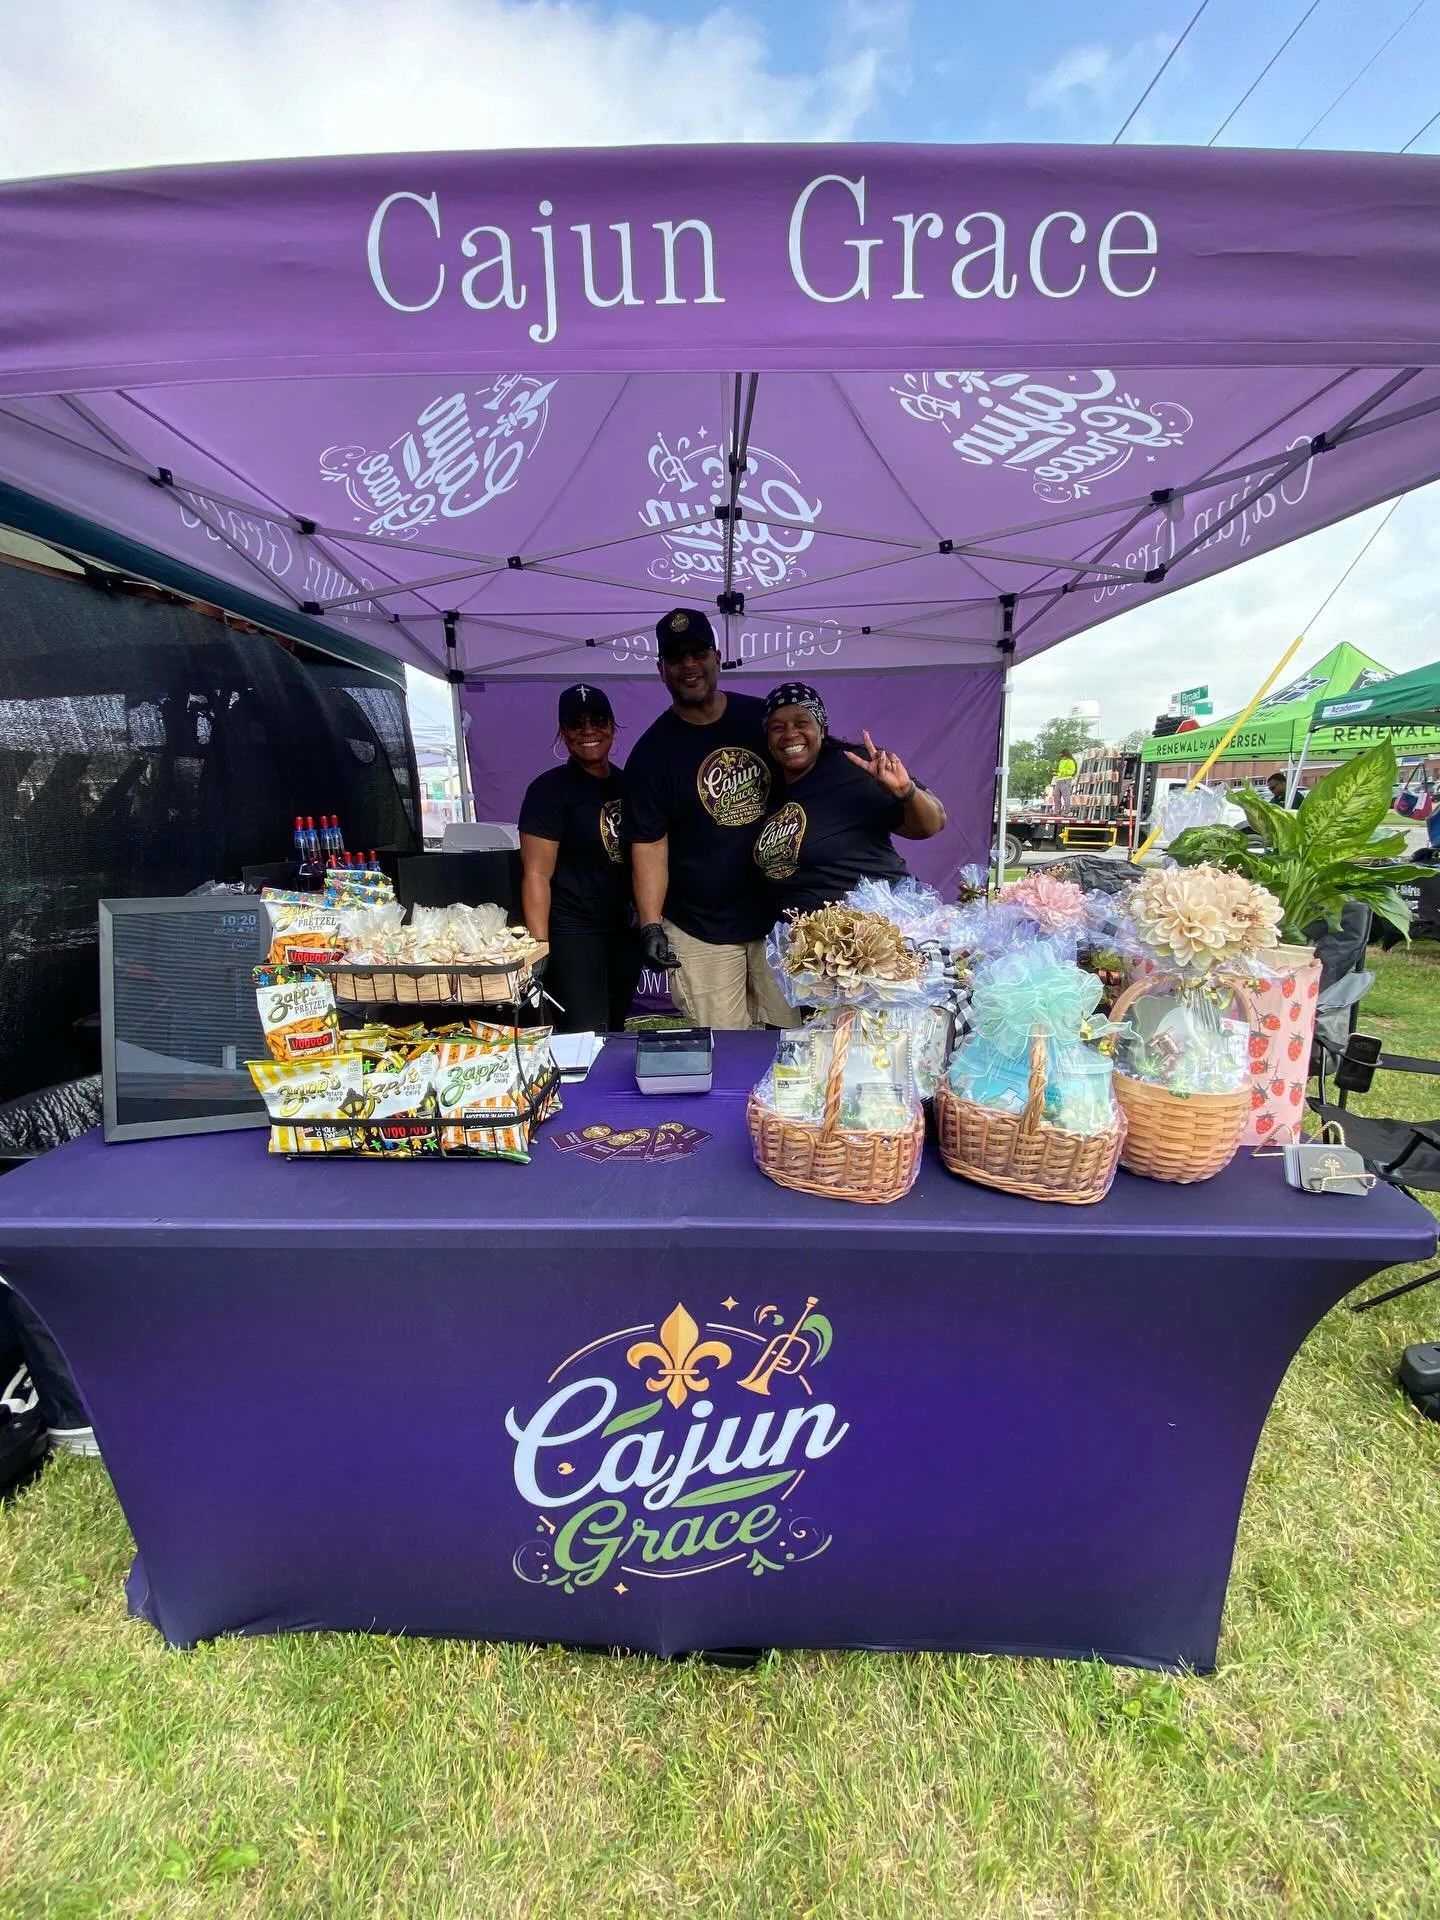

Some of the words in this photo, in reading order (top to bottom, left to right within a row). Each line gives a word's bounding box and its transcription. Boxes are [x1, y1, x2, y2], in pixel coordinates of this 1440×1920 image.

[366, 190, 727, 345] Cajun
[787, 174, 1160, 305] Grace
[1181, 690, 1201, 703] Broad
[1181, 705, 1196, 716] Elm
[1333, 725, 1432, 742] RENEWAL
[1156, 740, 1199, 756] RENEWAL
[1208, 733, 1267, 751] ANERSEN
[703, 764, 761, 799] Cajun
[720, 786, 754, 813] Grace
[758, 821, 799, 851] Cajun
[222, 914, 257, 927] 10:20
[297, 915, 338, 928] PRETZEL
[290, 951, 329, 963] VOODOO
[294, 999, 328, 1015] PRETZEL
[291, 1035, 330, 1050] VOODOO
[383, 1126, 429, 1139] VOOOO
[504, 1377, 851, 1512] Cajun
[553, 1499, 783, 1587] Grace
